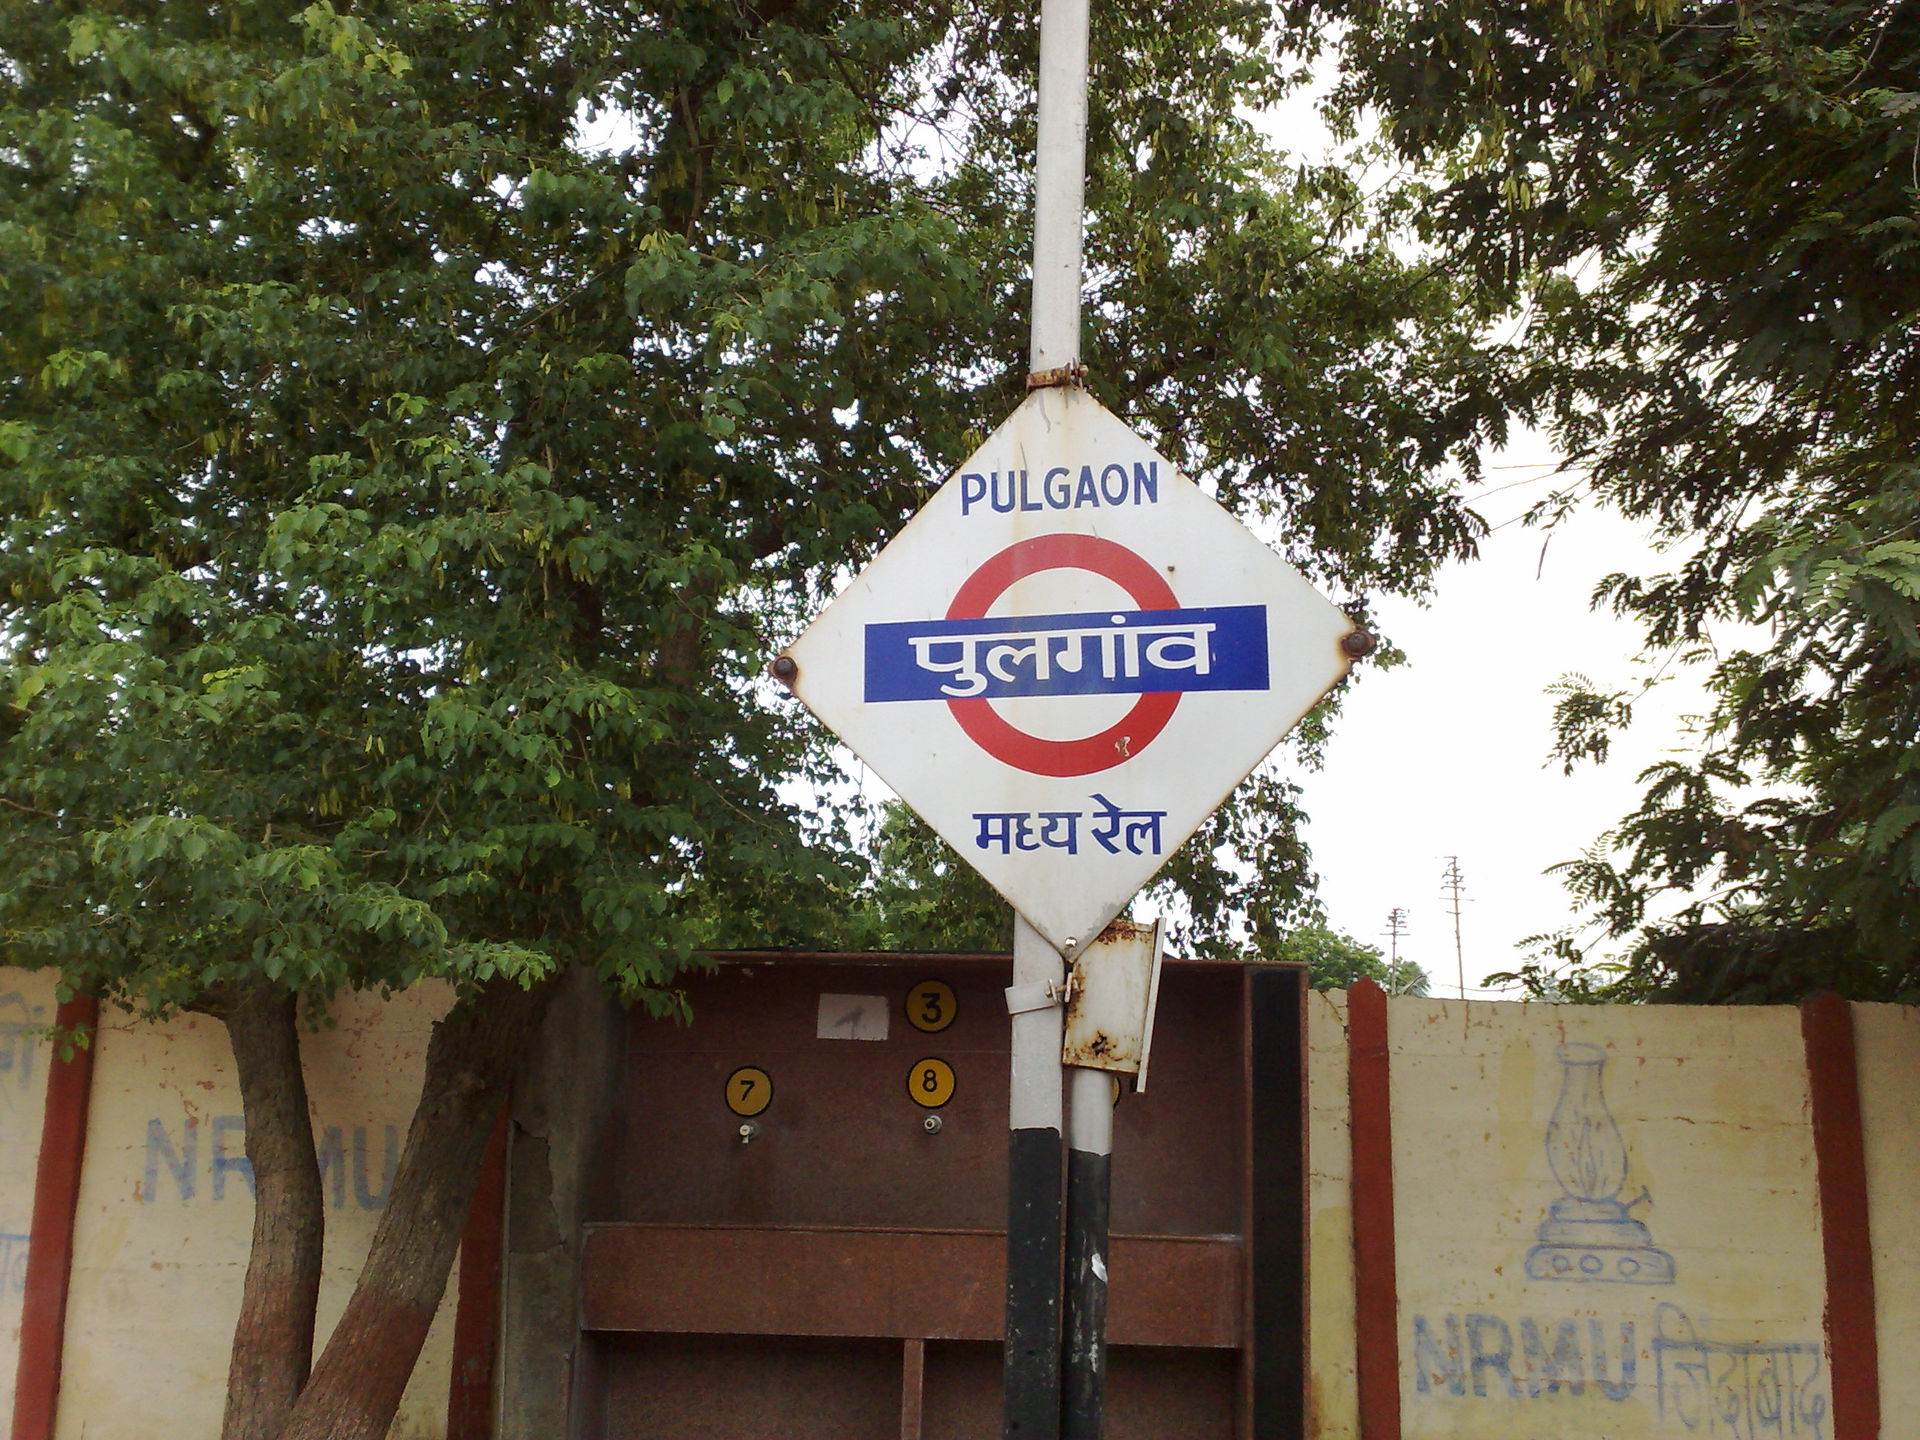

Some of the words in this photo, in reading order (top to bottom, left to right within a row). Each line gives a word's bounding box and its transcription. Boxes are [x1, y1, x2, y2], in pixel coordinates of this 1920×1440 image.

[959, 461, 1159, 516] PULGAON
[908, 615, 1217, 697] पुलगांव
[972, 812, 1081, 856] मध्य
[1088, 793, 1167, 855] रेल
[920, 993, 942, 1024] 3
[740, 1080, 755, 1101] 7
[922, 1069, 938, 1092] 8
[1414, 1311, 1636, 1401] NRMU
